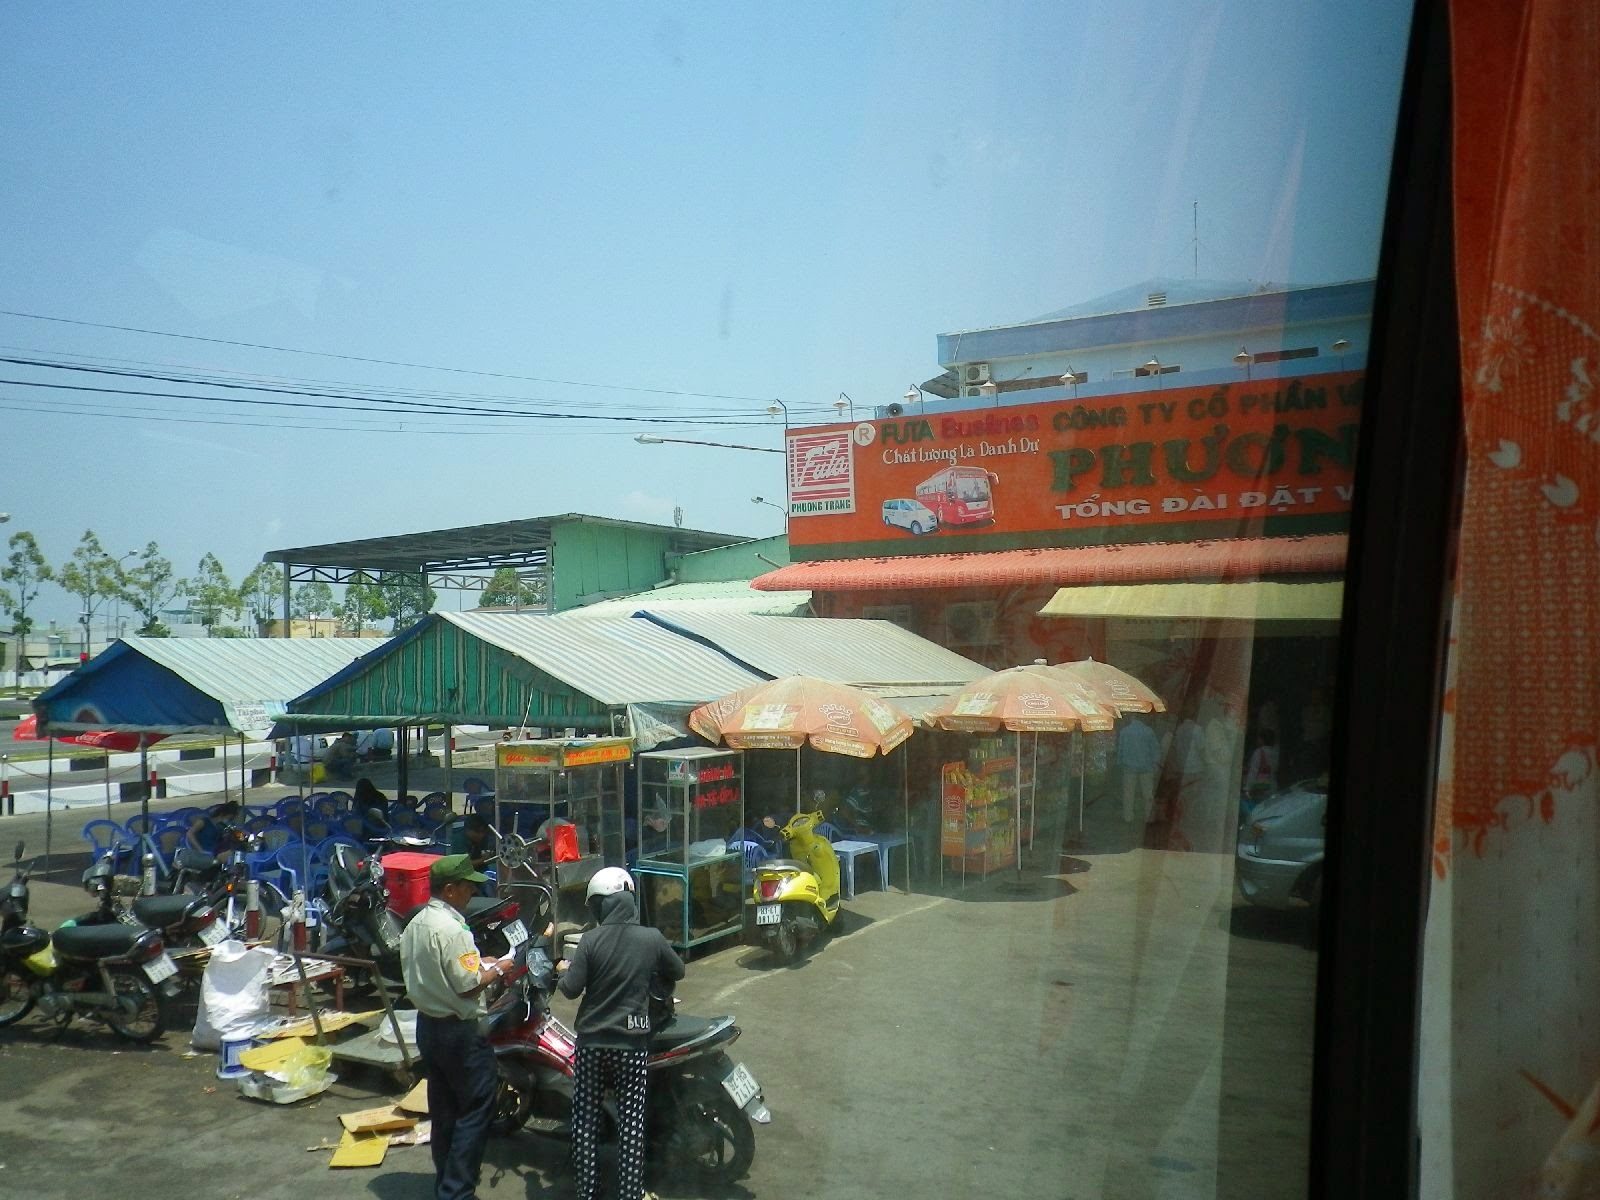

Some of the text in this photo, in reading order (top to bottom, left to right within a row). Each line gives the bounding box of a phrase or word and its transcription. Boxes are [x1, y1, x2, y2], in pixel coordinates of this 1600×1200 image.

[1138, 401, 1177, 425] TY
[881, 419, 936, 446] FUTA
[882, 447, 917, 465] Chất
[960, 443, 975, 459] Là
[979, 437, 1017, 457] Danh
[791, 499, 851, 513] PHUONG TRANG
[1055, 493, 1151, 521] TỔNG
[1161, 488, 1228, 512] ĐÀI
